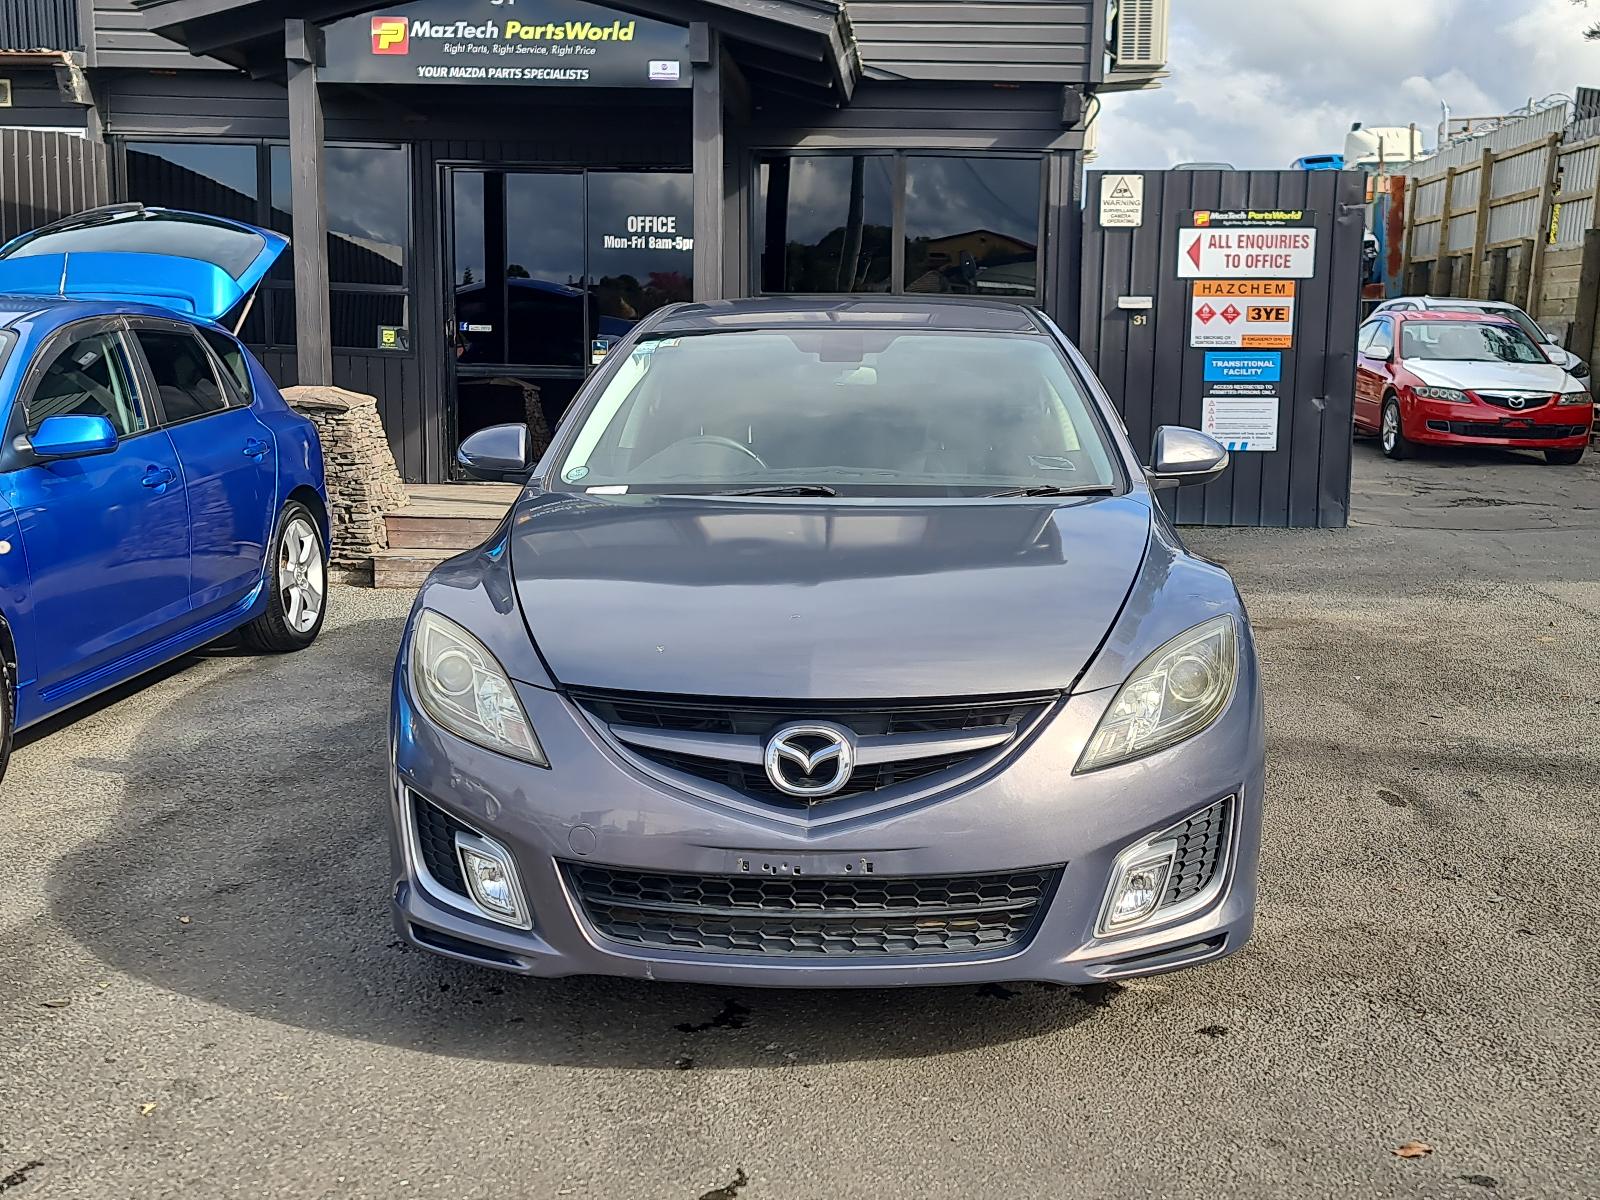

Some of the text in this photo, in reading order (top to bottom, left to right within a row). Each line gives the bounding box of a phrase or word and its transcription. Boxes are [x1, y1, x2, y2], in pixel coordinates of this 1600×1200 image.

[410, 20, 635, 41] MazTech PartsWorld
[444, 43, 596, 56] Right Parts, Right Service, Right Price
[417, 66, 589, 80] YOUR MAZDA PARTS SPECIALISTS
[1210, 211, 1302, 220] MazTech PartsWorld
[627, 216, 676, 233] OFFICE
[604, 235, 645, 249] Mon-Fri
[1208, 234, 1310, 250] ALL ENQUIRIES
[1225, 254, 1291, 269] TO OFFICE
[1202, 283, 1286, 294] HAZCHEM
[1133, 315, 1147, 325] 31
[1251, 307, 1285, 320] 3YE
